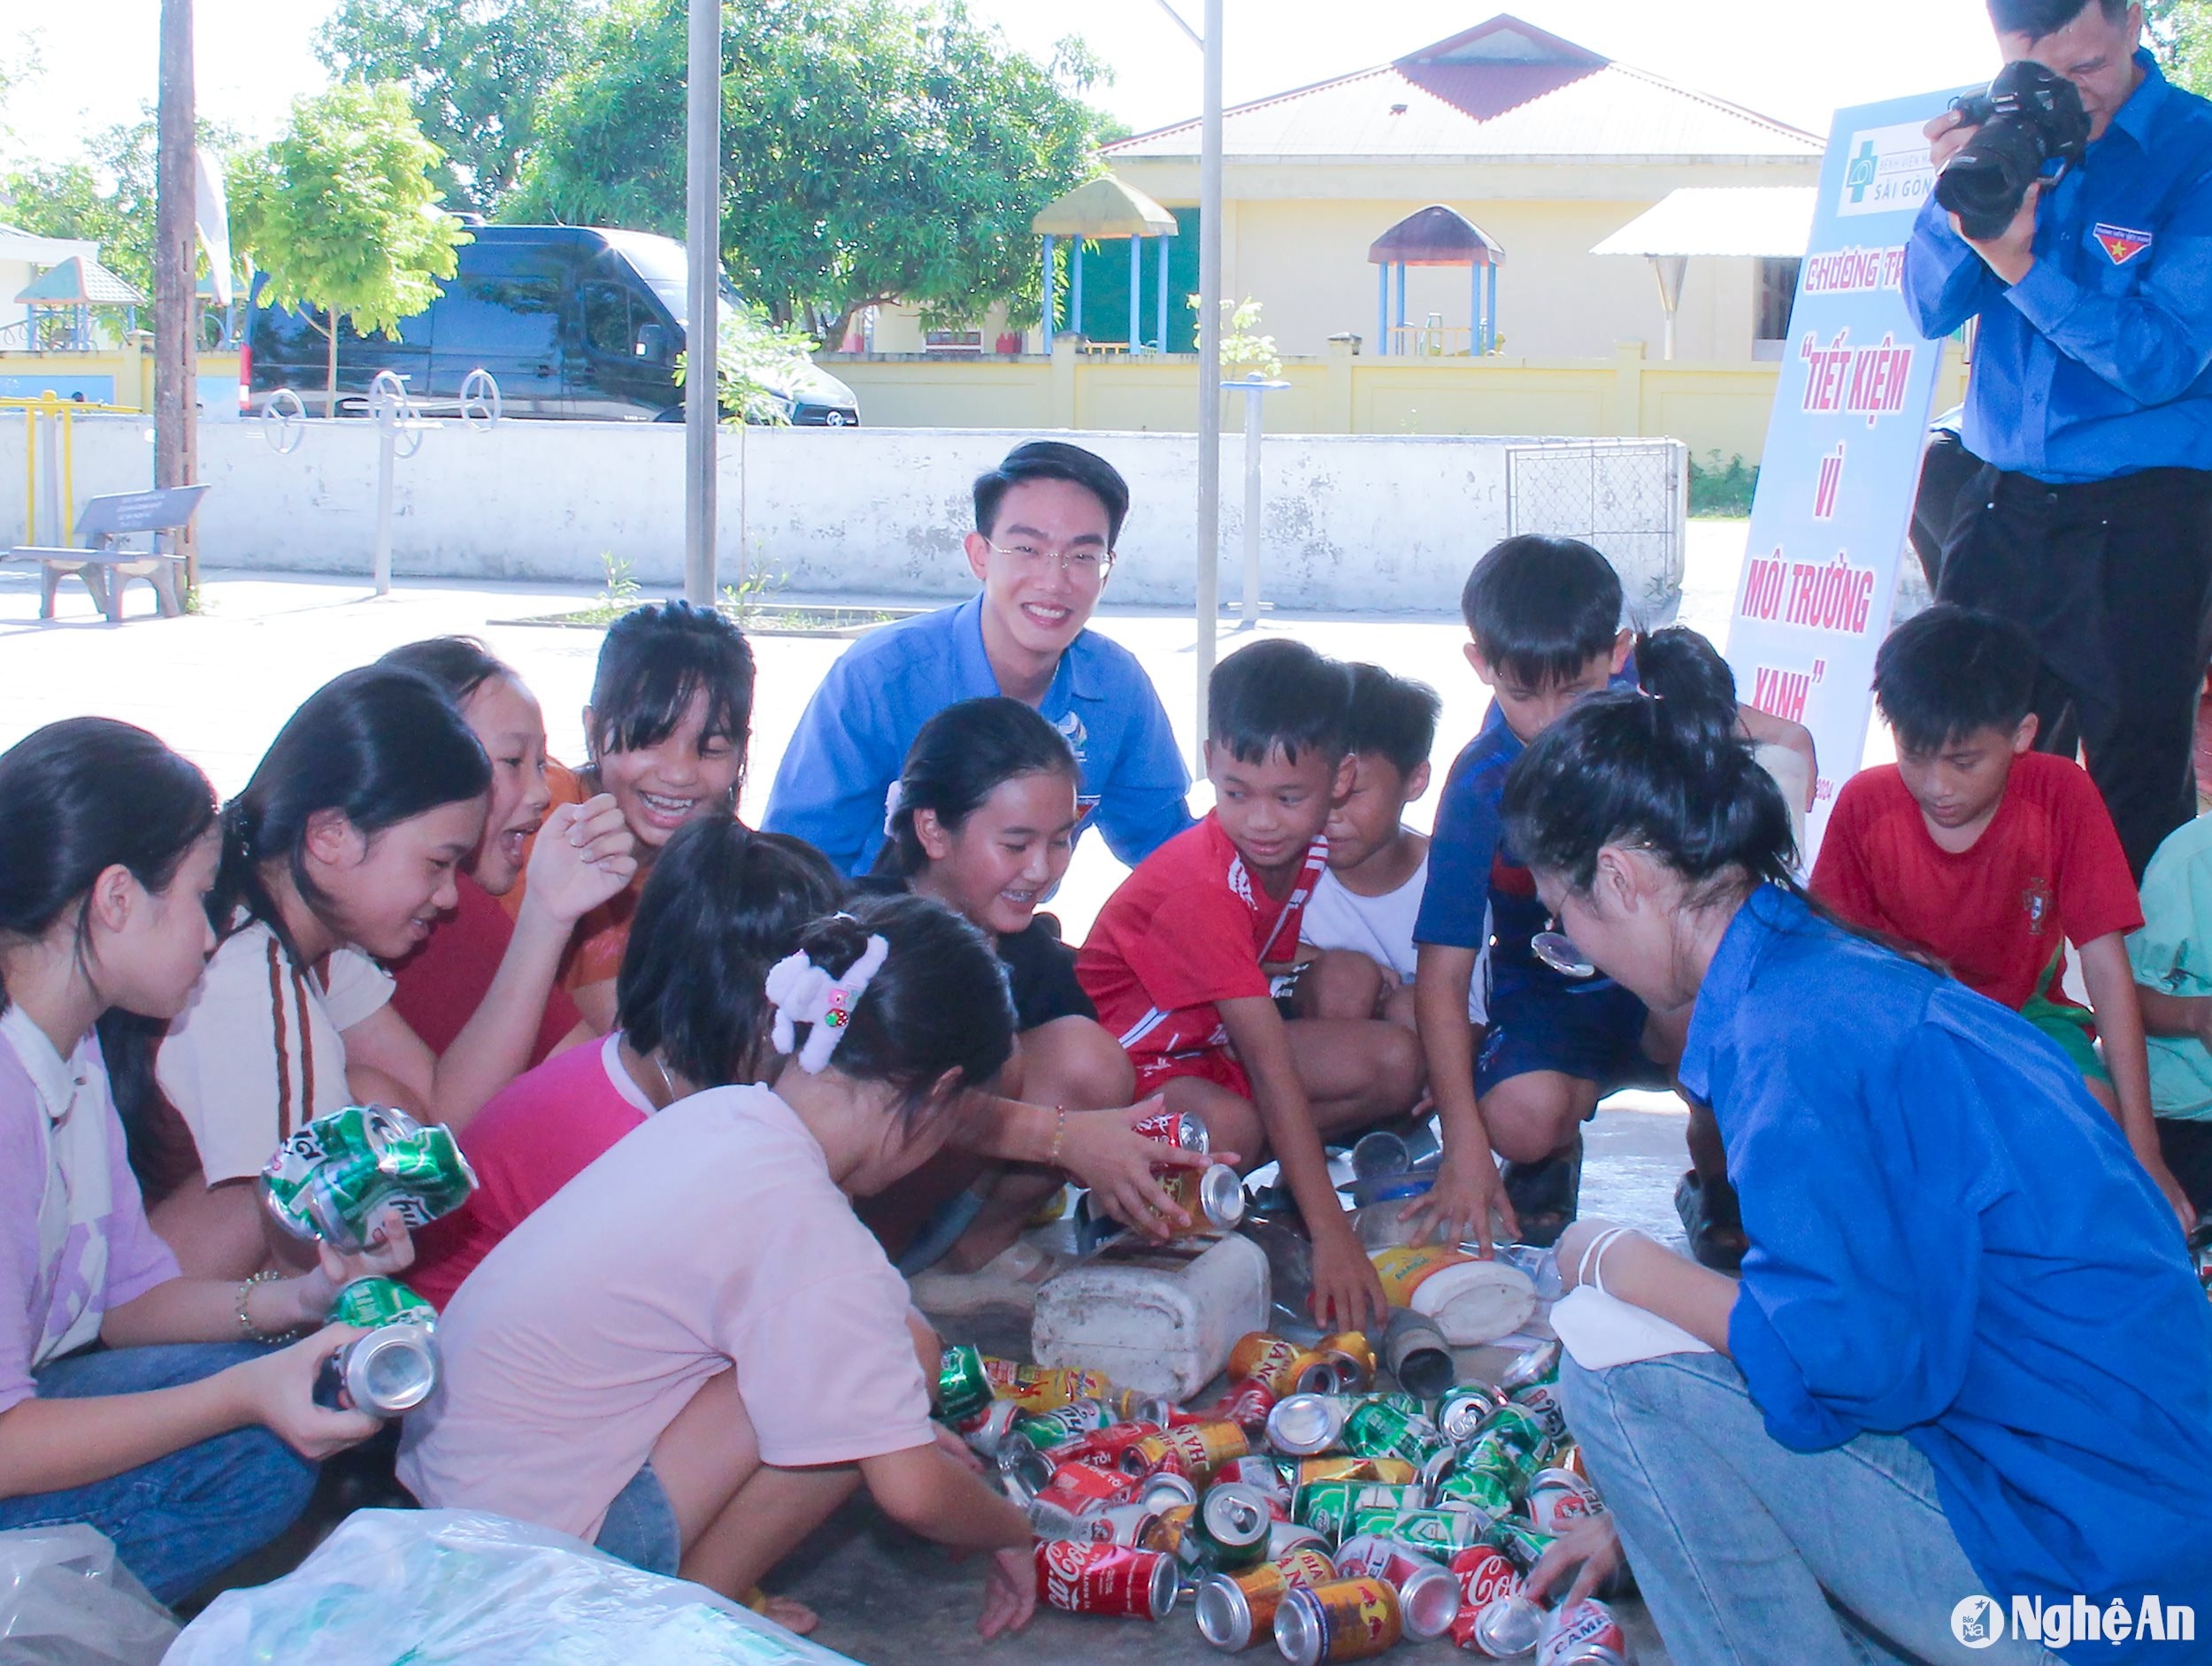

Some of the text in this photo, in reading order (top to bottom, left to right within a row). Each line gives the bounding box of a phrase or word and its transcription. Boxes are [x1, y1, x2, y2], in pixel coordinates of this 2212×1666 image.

[1874, 174, 1932, 200] SÀI GÒN
[1805, 250, 1907, 291] CHƯƠNG TR
[1847, 336, 1911, 425] KIỆM
[1815, 444, 1843, 518] VÌ
[1741, 548, 1874, 633] MÔI TRƯỜNG
[1301, 1555, 1324, 1580] BIA
